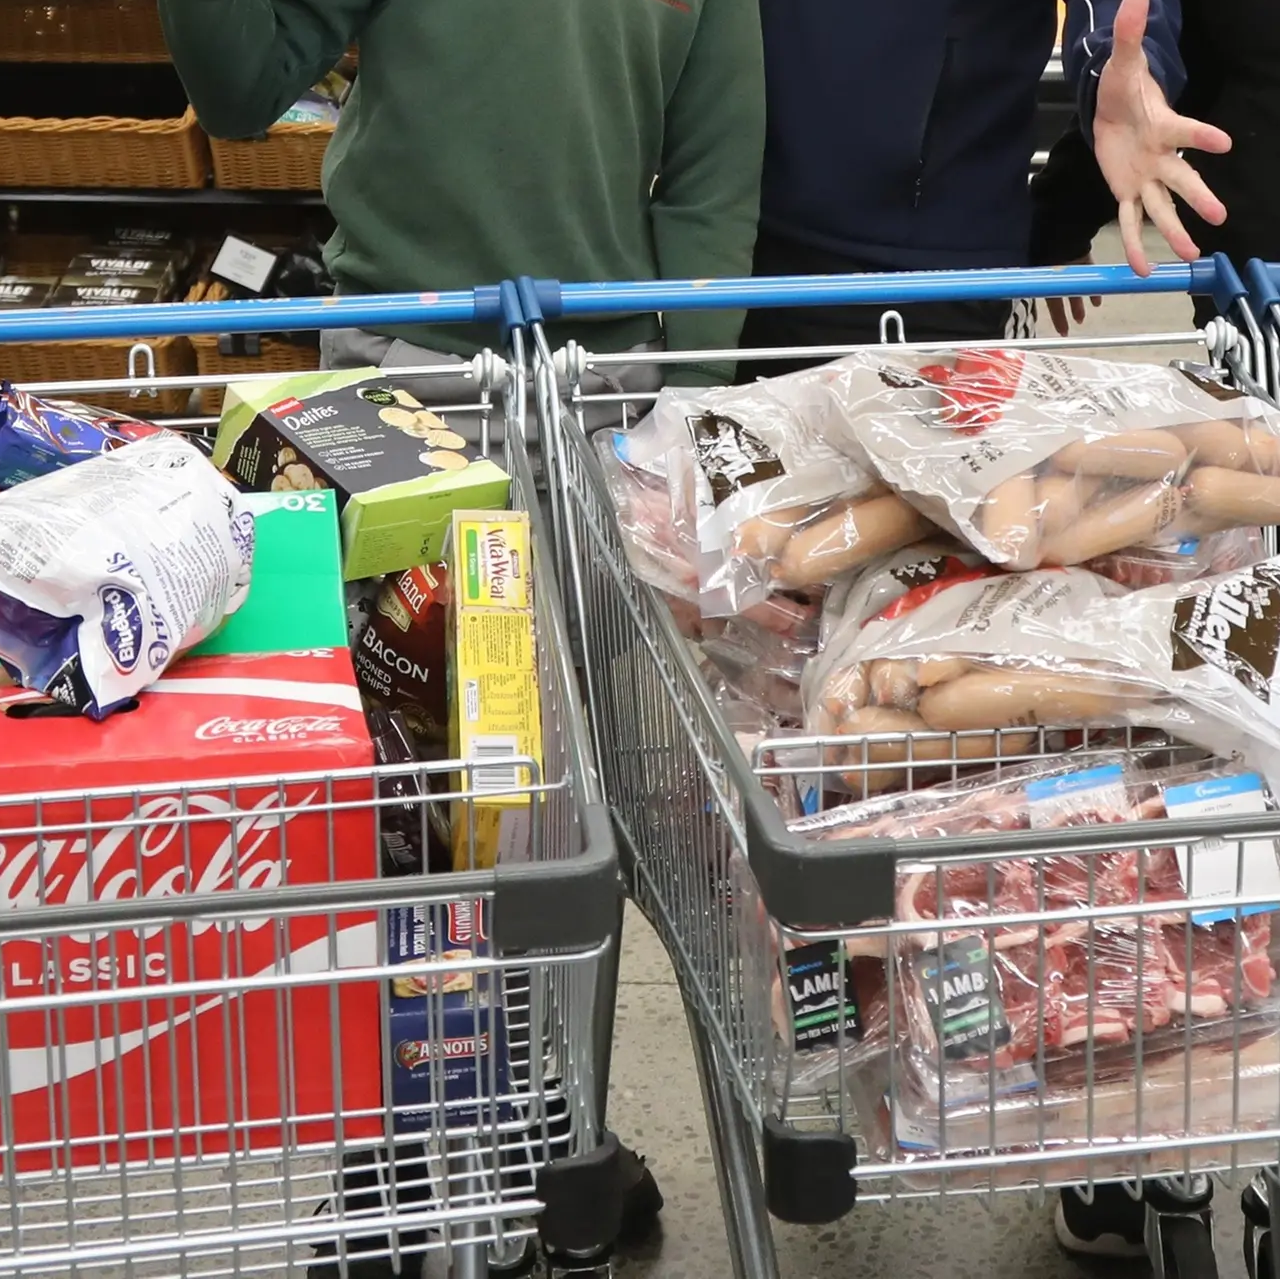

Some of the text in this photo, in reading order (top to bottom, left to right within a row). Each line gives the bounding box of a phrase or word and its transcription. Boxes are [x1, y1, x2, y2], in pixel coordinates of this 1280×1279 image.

[282, 404, 339, 432] Delites
[281, 491, 327, 513] 30
[356, 650, 393, 685] HIONED
[362, 624, 430, 684] BACON
[360, 668, 391, 698] CHIPS
[196, 715, 343, 742] Coca-Cola
[232, 731, 308, 744] CLASSIC
